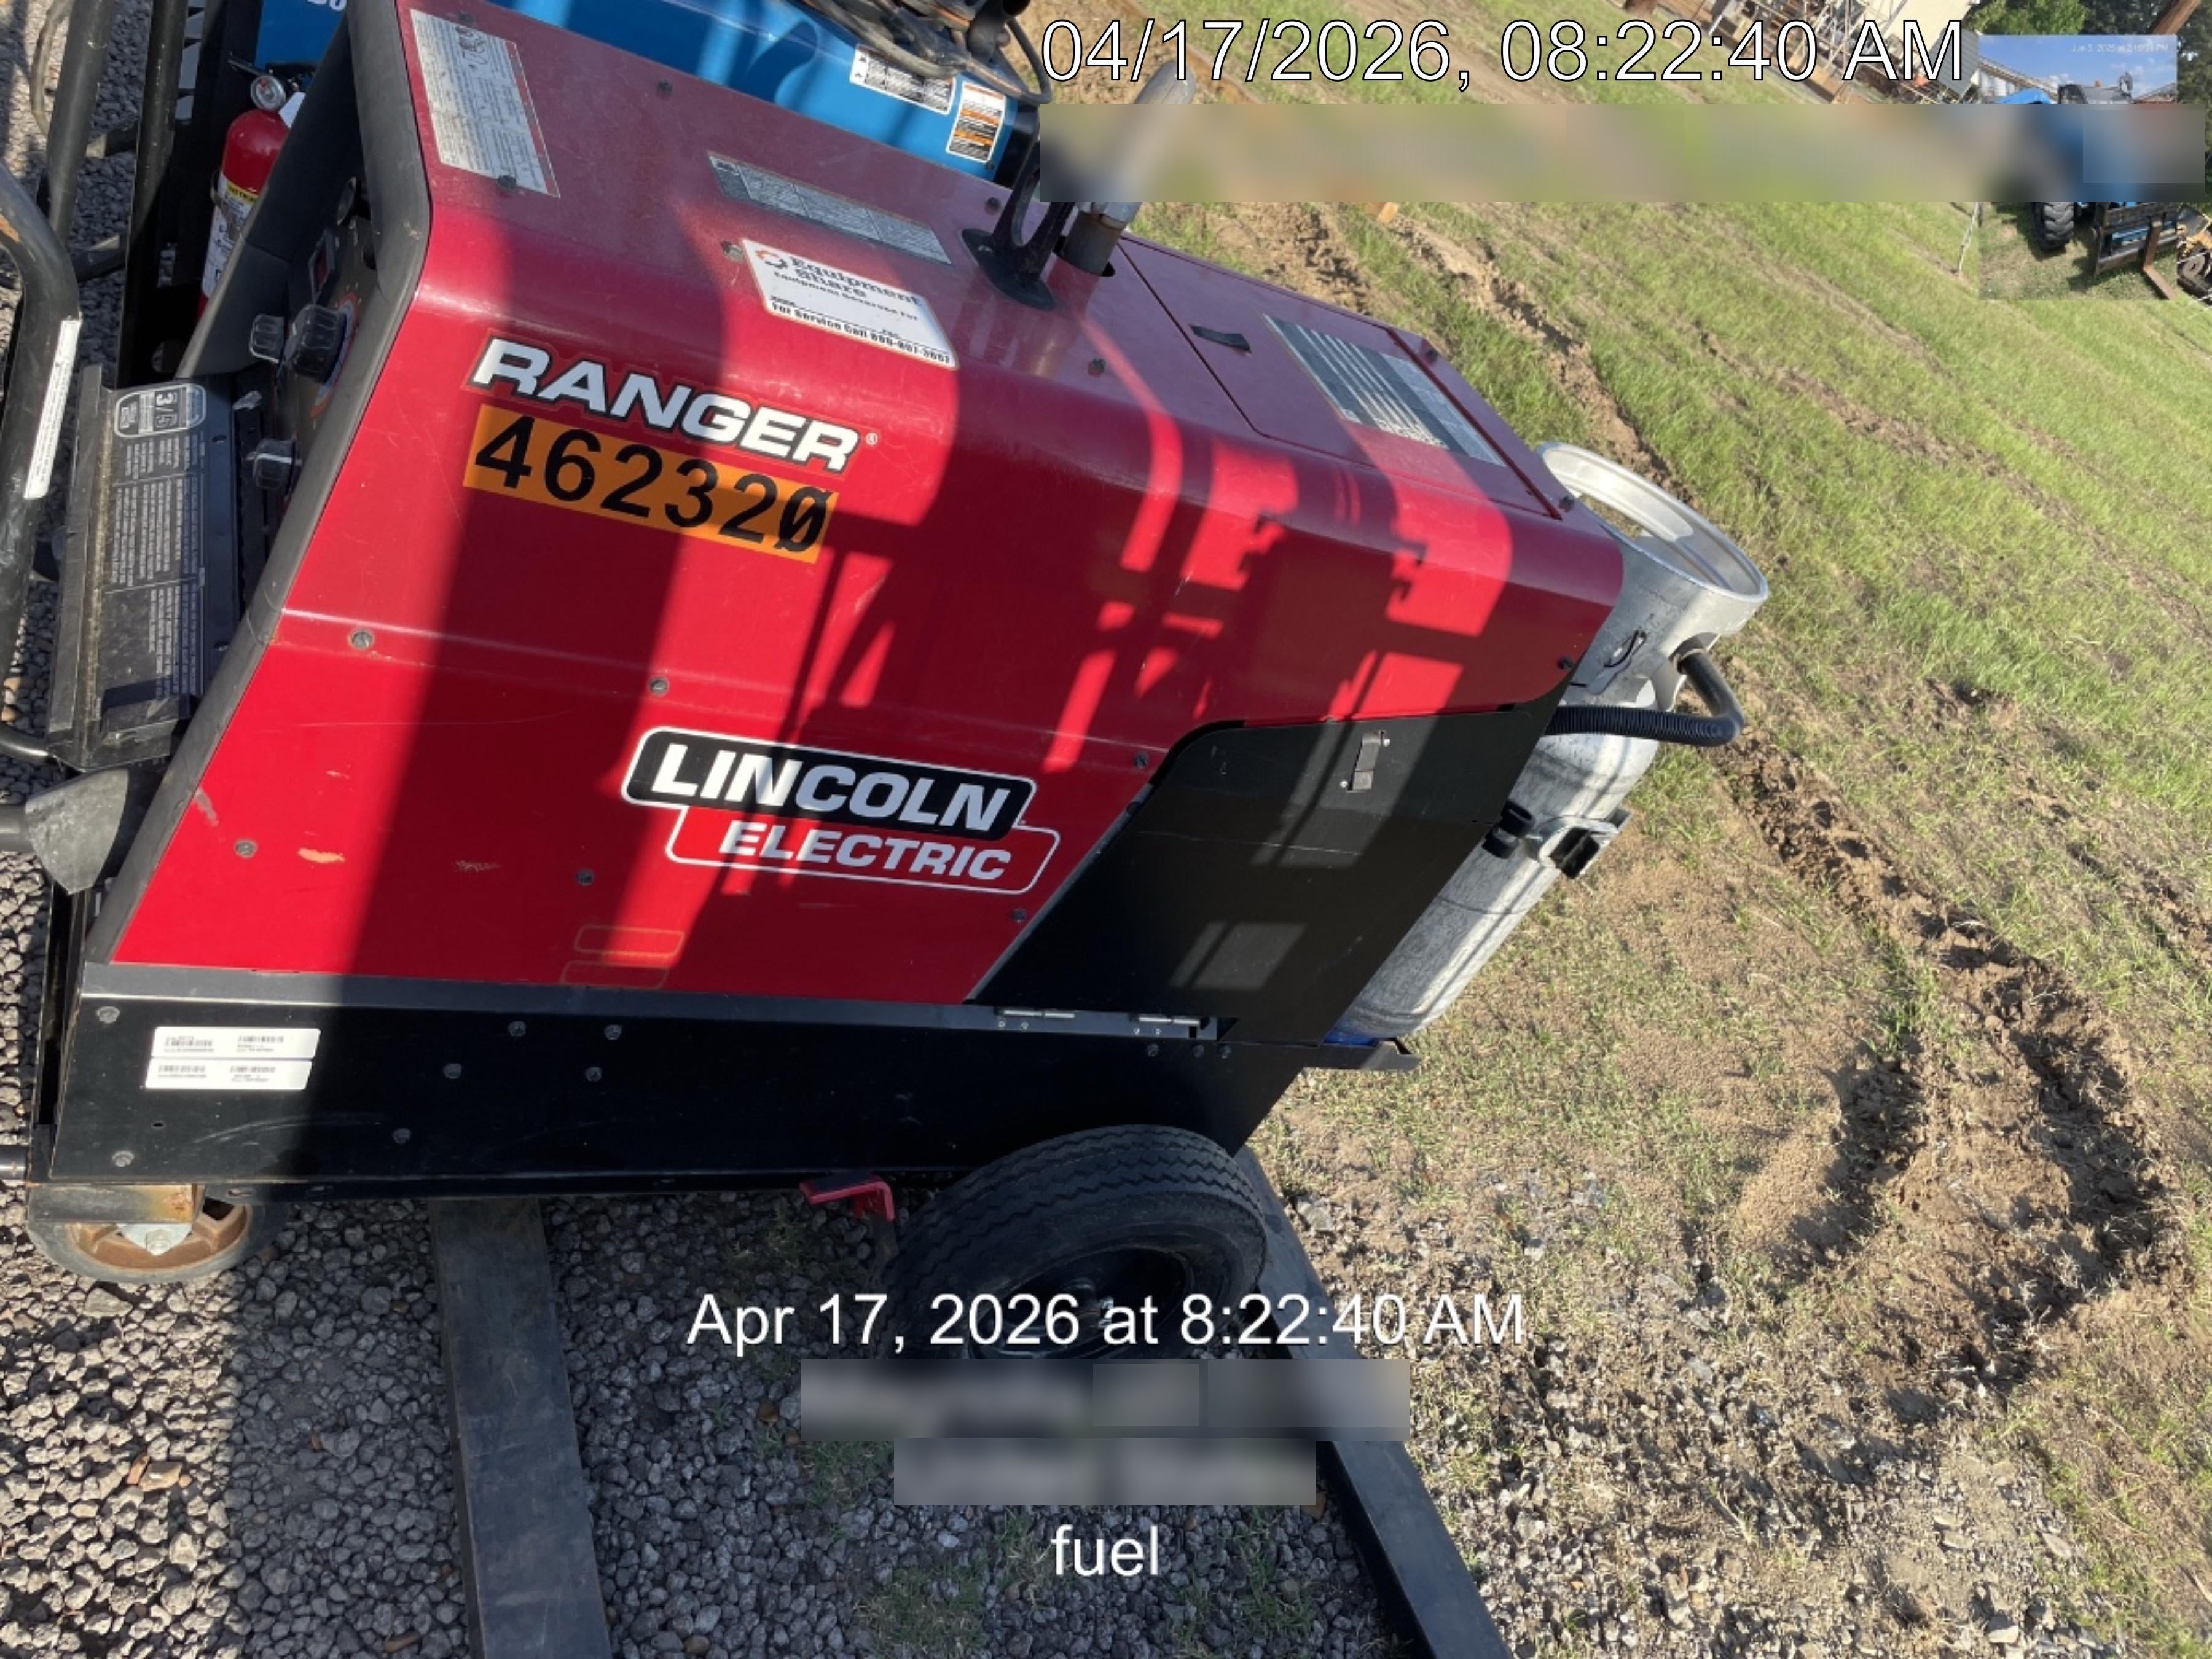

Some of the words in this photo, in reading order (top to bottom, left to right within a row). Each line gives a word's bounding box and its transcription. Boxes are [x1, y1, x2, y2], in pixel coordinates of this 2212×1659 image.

[789, 256, 922, 306] Equipment
[772, 301, 791, 315] For
[794, 308, 841, 331] Service
[844, 323, 867, 338] Call
[471, 335, 860, 473] RANGER
[651, 743, 1011, 831] LINCOLN
[719, 820, 1012, 881] ELECTRIC
